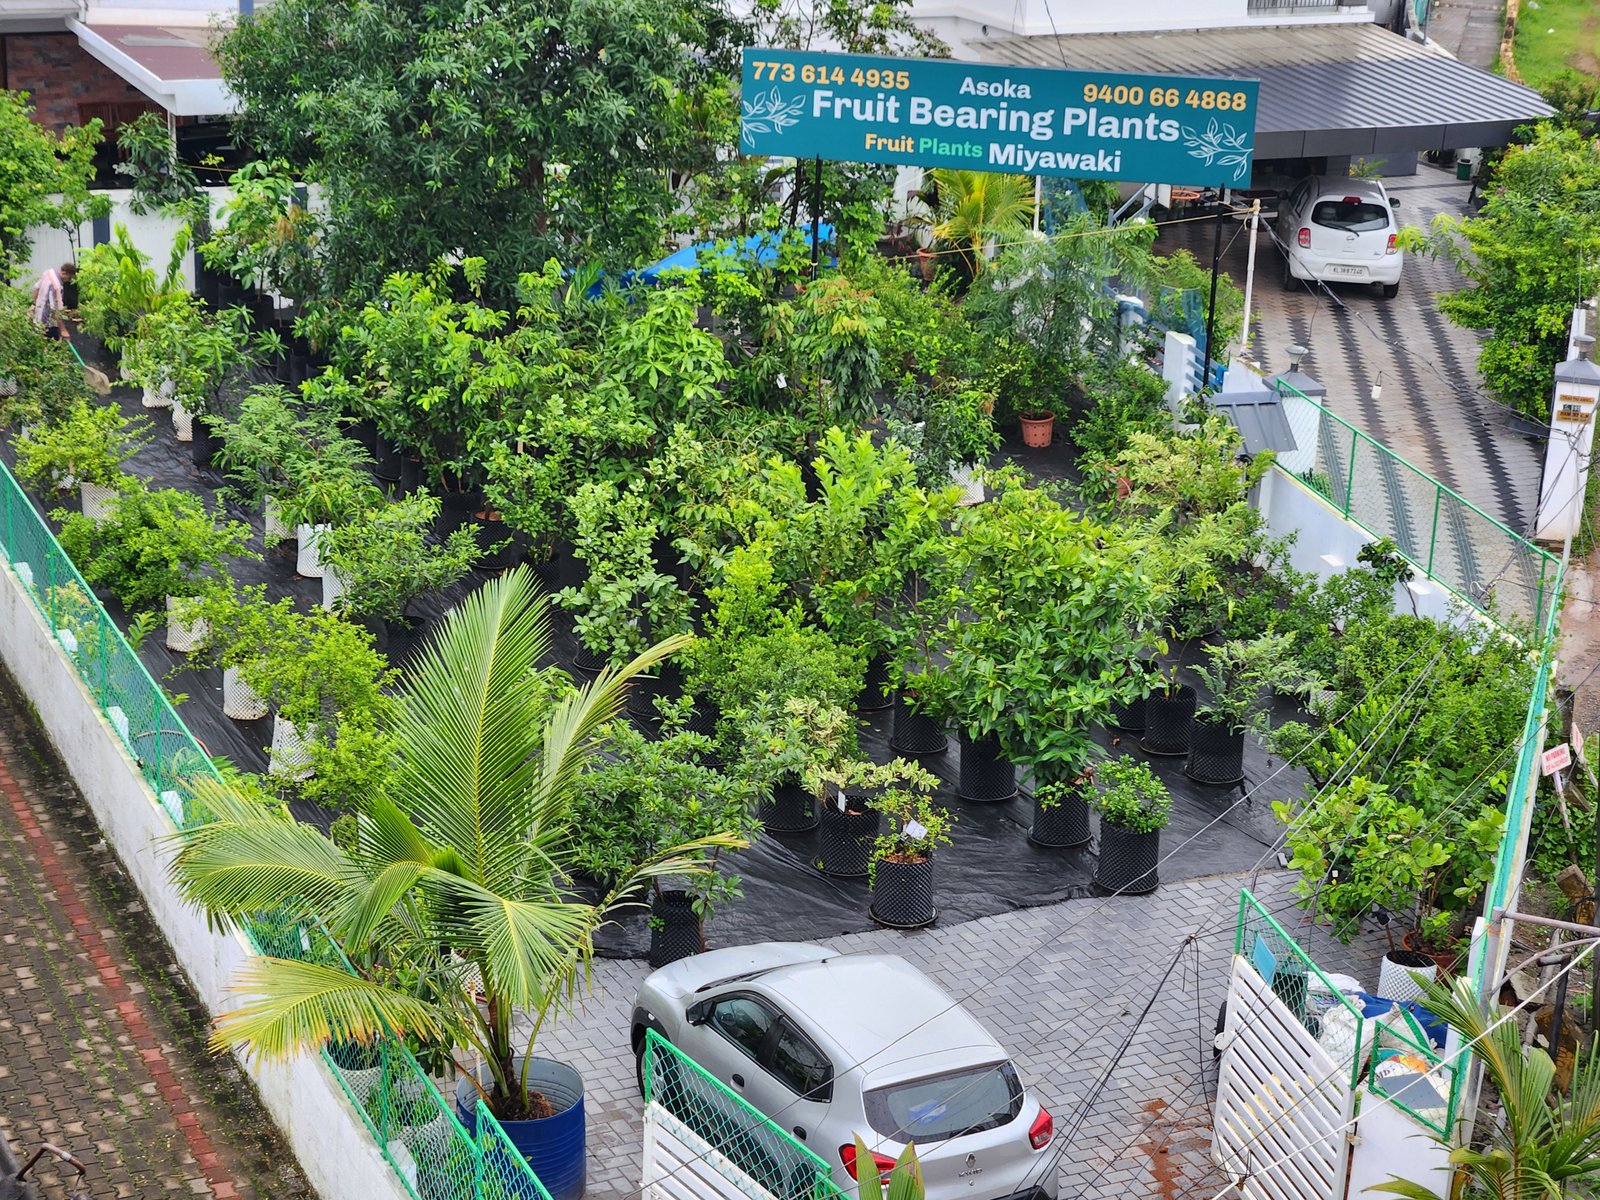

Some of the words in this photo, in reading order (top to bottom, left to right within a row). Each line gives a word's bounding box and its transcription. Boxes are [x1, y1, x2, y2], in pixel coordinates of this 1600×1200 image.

[752, 61, 795, 82] 773
[801, 65, 845, 86] 614
[850, 68, 910, 90] 4935
[959, 76, 1031, 99] Asoka
[1083, 84, 1144, 105] 9400
[1149, 87, 1180, 107] 66
[1185, 89, 1247, 111] 4868
[813, 89, 900, 123] Fruit
[909, 96, 1055, 141] Bearing
[1063, 107, 1180, 142] Plants
[865, 133, 914, 153] Fruit
[919, 137, 983, 158] Plants
[988, 143, 1121, 173] Miyawaki
